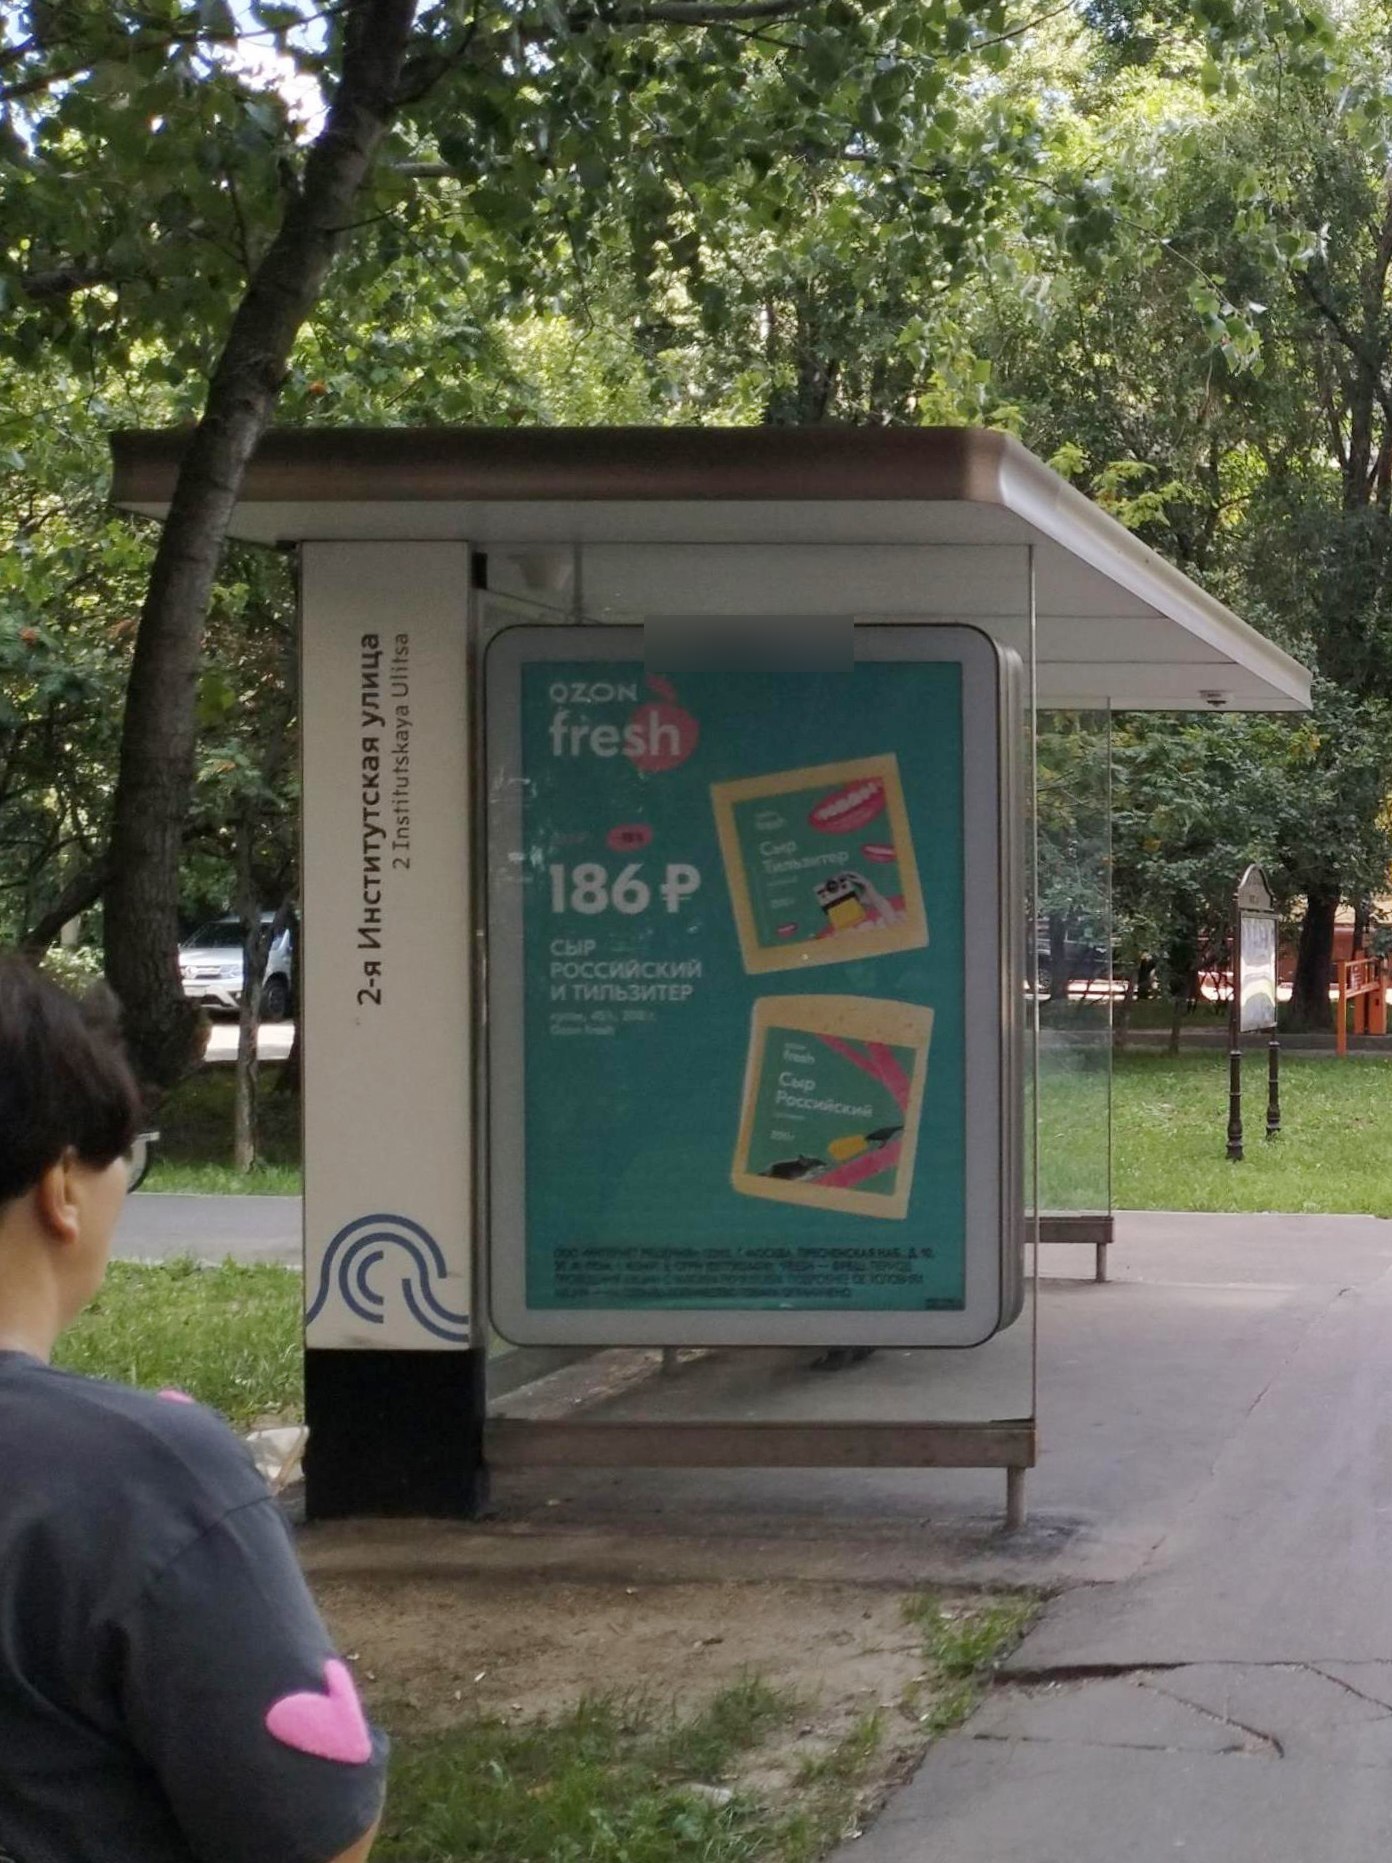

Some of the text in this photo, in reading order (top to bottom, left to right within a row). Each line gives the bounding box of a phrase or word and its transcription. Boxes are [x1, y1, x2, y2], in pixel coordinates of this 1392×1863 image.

[549, 681, 638, 703] OZON
[548, 709, 682, 757] fresh
[389, 633, 413, 870] 2 Institutskaya Ulitsa
[357, 633, 387, 1006] 2-я Институтская улица
[550, 863, 651, 915] 186
[551, 938, 596, 957] СЫР
[551, 957, 702, 979] РОССИЙСКИЙ
[551, 984, 694, 1002] И ТИЛЬЗИТЕР
[779, 1071, 816, 1093] Сыр
[775, 1089, 873, 1118] Российский
